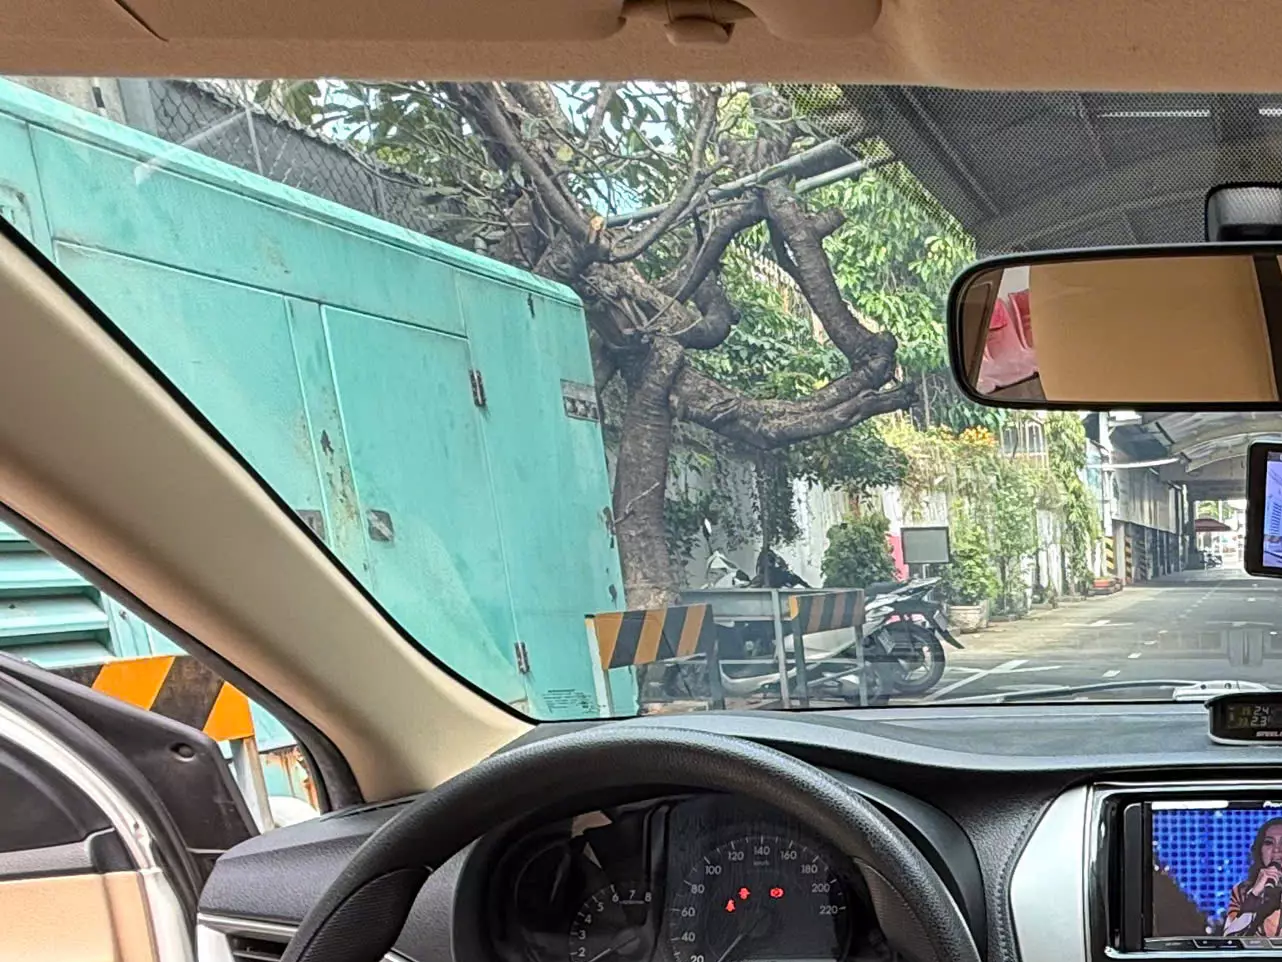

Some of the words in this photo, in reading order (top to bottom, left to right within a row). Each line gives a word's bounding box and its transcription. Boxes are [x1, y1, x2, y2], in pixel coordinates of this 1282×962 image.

[728, 852, 744, 861] 120
[754, 847, 770, 856] 140
[781, 851, 797, 860] 160
[705, 865, 721, 875] 100
[801, 864, 817, 874] 180
[691, 884, 705, 894] 80
[812, 883, 830, 893] 200
[612, 893, 619, 902] 6
[629, 889, 636, 899] 7
[644, 892, 652, 902] 8
[597, 901, 604, 912] 5
[819, 905, 838, 914] 220
[681, 908, 695, 917] 60
[584, 914, 592, 924] 4
[578, 930, 586, 940] 3
[681, 932, 695, 941] 40
[578, 947, 586, 957] 2
